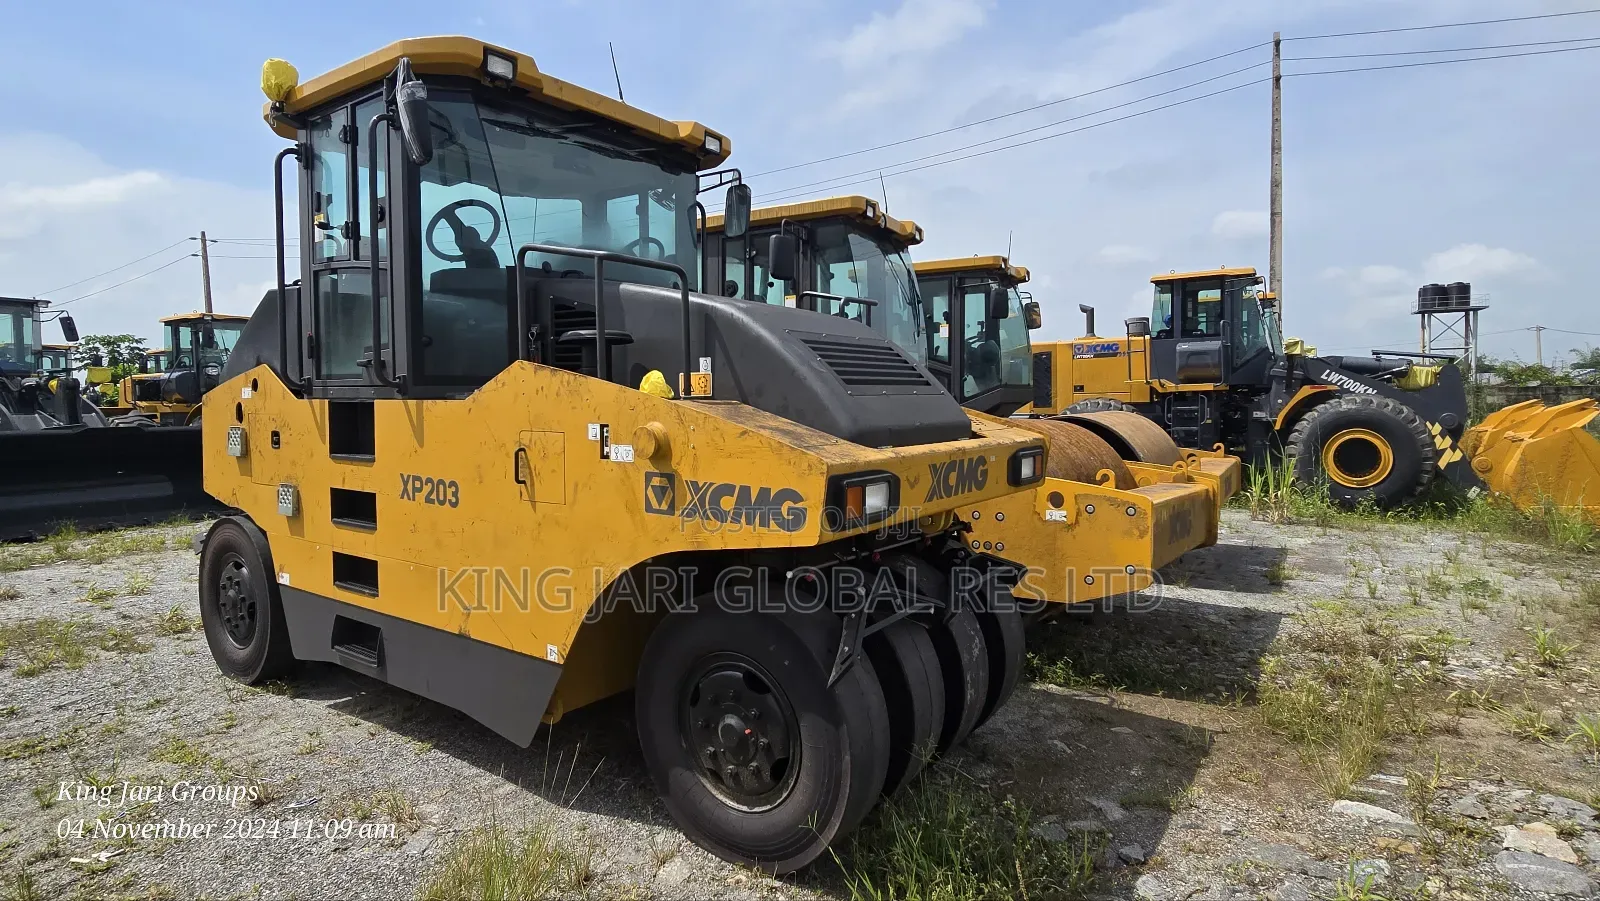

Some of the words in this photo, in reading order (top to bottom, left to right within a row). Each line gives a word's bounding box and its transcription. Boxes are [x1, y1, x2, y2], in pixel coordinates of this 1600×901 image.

[1084, 342, 1120, 354] XCMG
[399, 472, 460, 509] XP203
[923, 455, 988, 504] XCMG
[679, 479, 808, 533] XCMG
